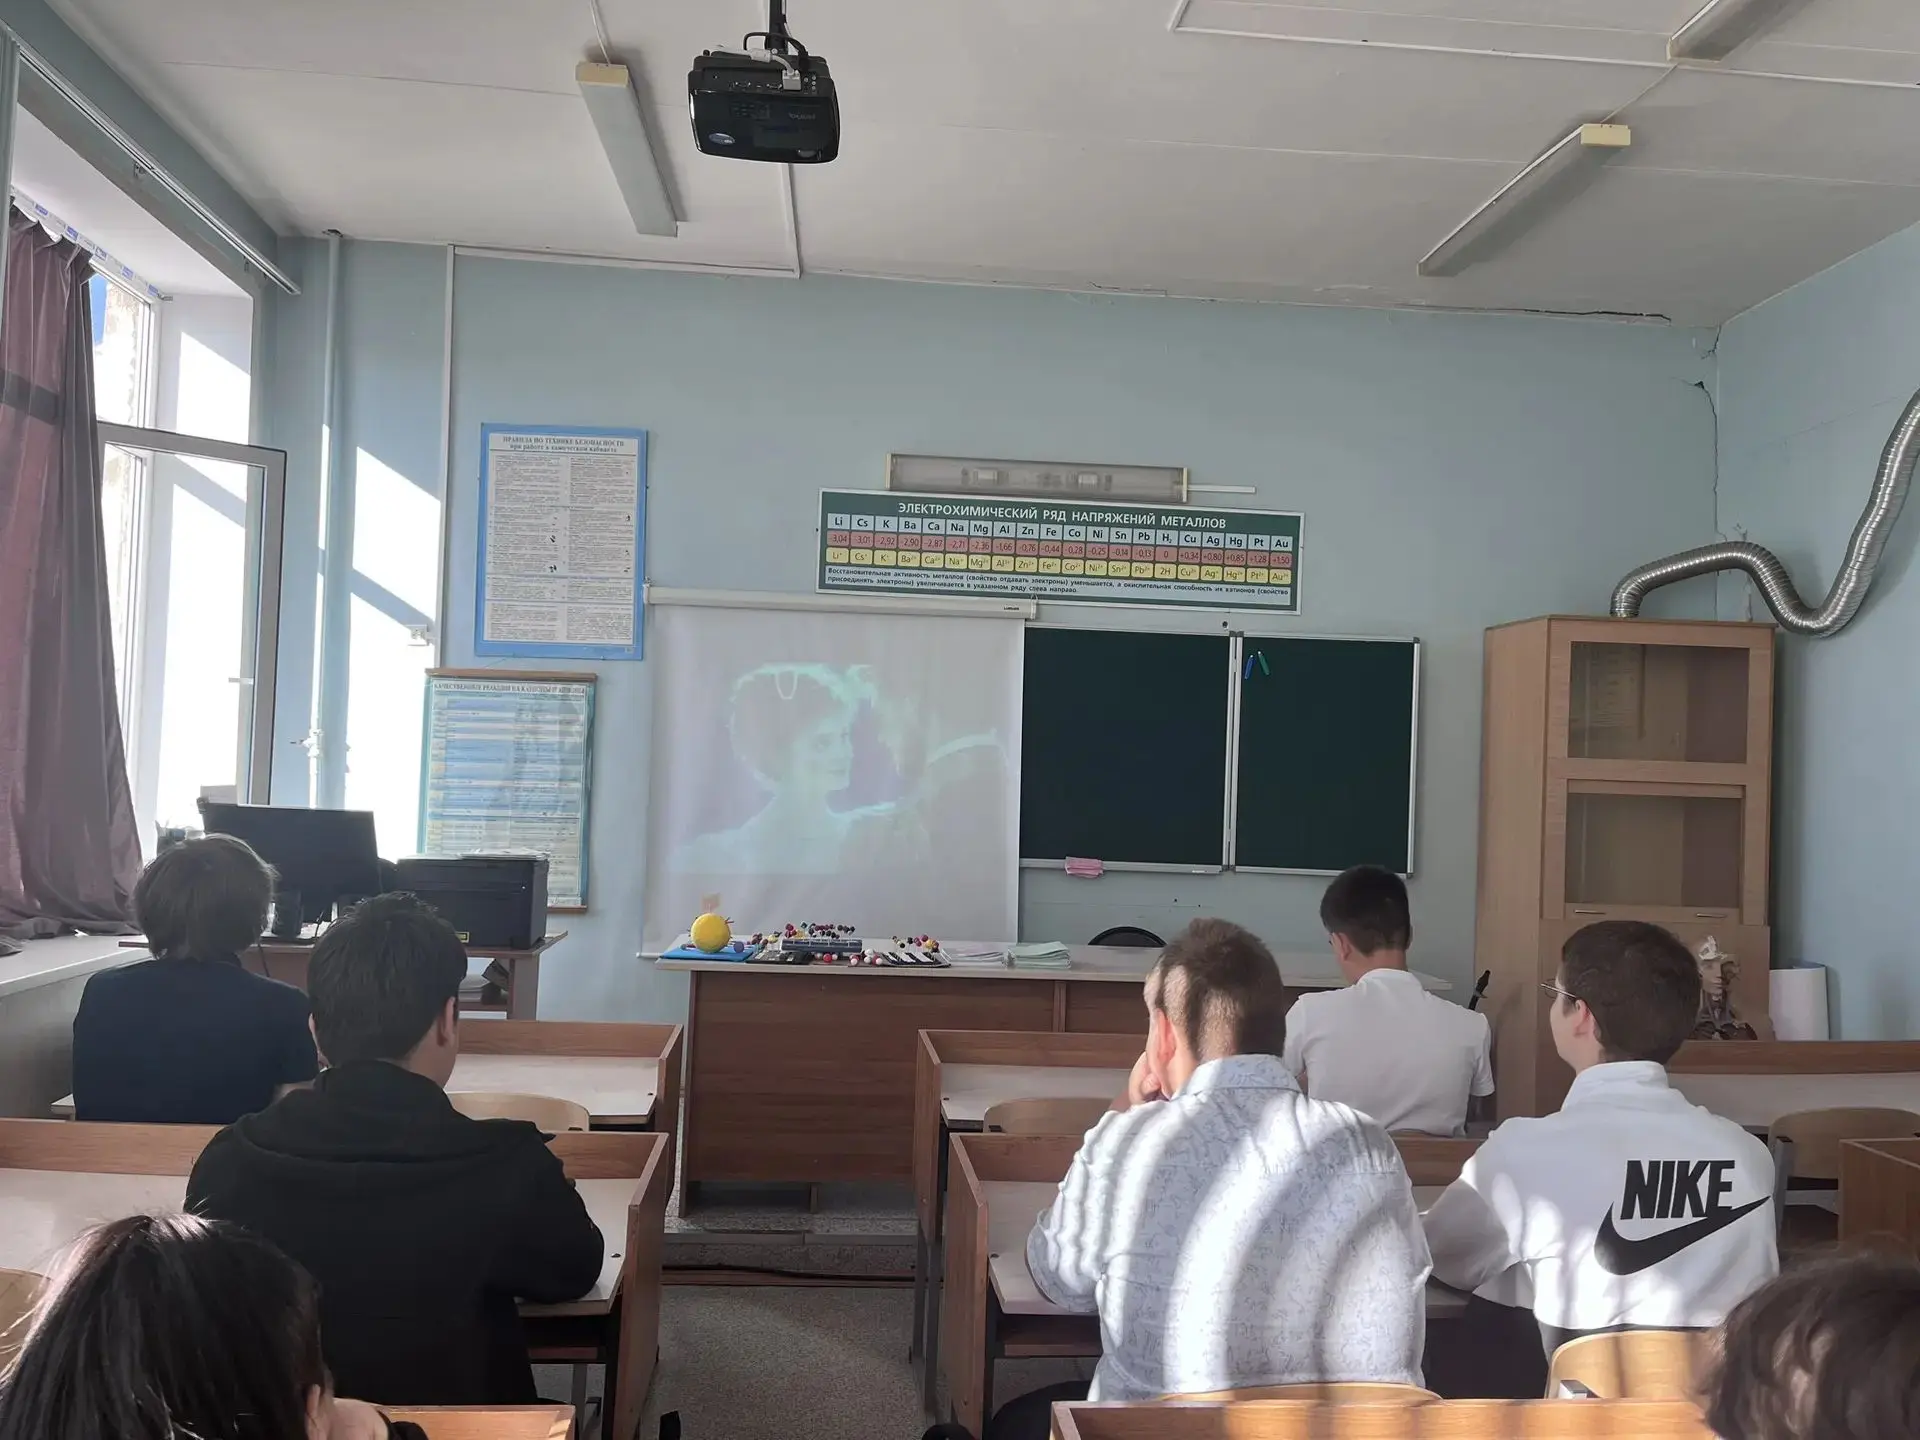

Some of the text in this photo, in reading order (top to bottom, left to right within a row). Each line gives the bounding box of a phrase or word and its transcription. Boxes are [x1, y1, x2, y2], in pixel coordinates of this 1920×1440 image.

[898, 503, 1226, 529] ЭЛЕКТРОХИМИЧЕСКИЙ РЯД НАПРЯЖЕНИЙ МЕТАЛЛОВ
[835, 517, 842, 525] Li
[857, 519, 868, 527] Cs
[904, 521, 916, 529] Ba
[928, 522, 939, 530] Ca
[951, 523, 964, 531] Na
[974, 524, 988, 534] Mg
[1000, 526, 1009, 534] Al
[1022, 527, 1034, 535] Zn
[1046, 528, 1056, 536] Fe
[1069, 529, 1080, 537] Co
[1093, 530, 1103, 538] Ni
[1115, 531, 1126, 539] Sn
[1139, 532, 1150, 540] Pb
[1184, 535, 1196, 543] Cu
[1207, 536, 1219, 546] Ag
[1230, 537, 1242, 547] Hg
[1254, 538, 1263, 546] Pt
[1275, 540, 1288, 548] Au
[828, 576, 873, 584] присоединять
[829, 568, 890, 576] Восстановительная
[1620, 1160, 1735, 1220] NIKE
